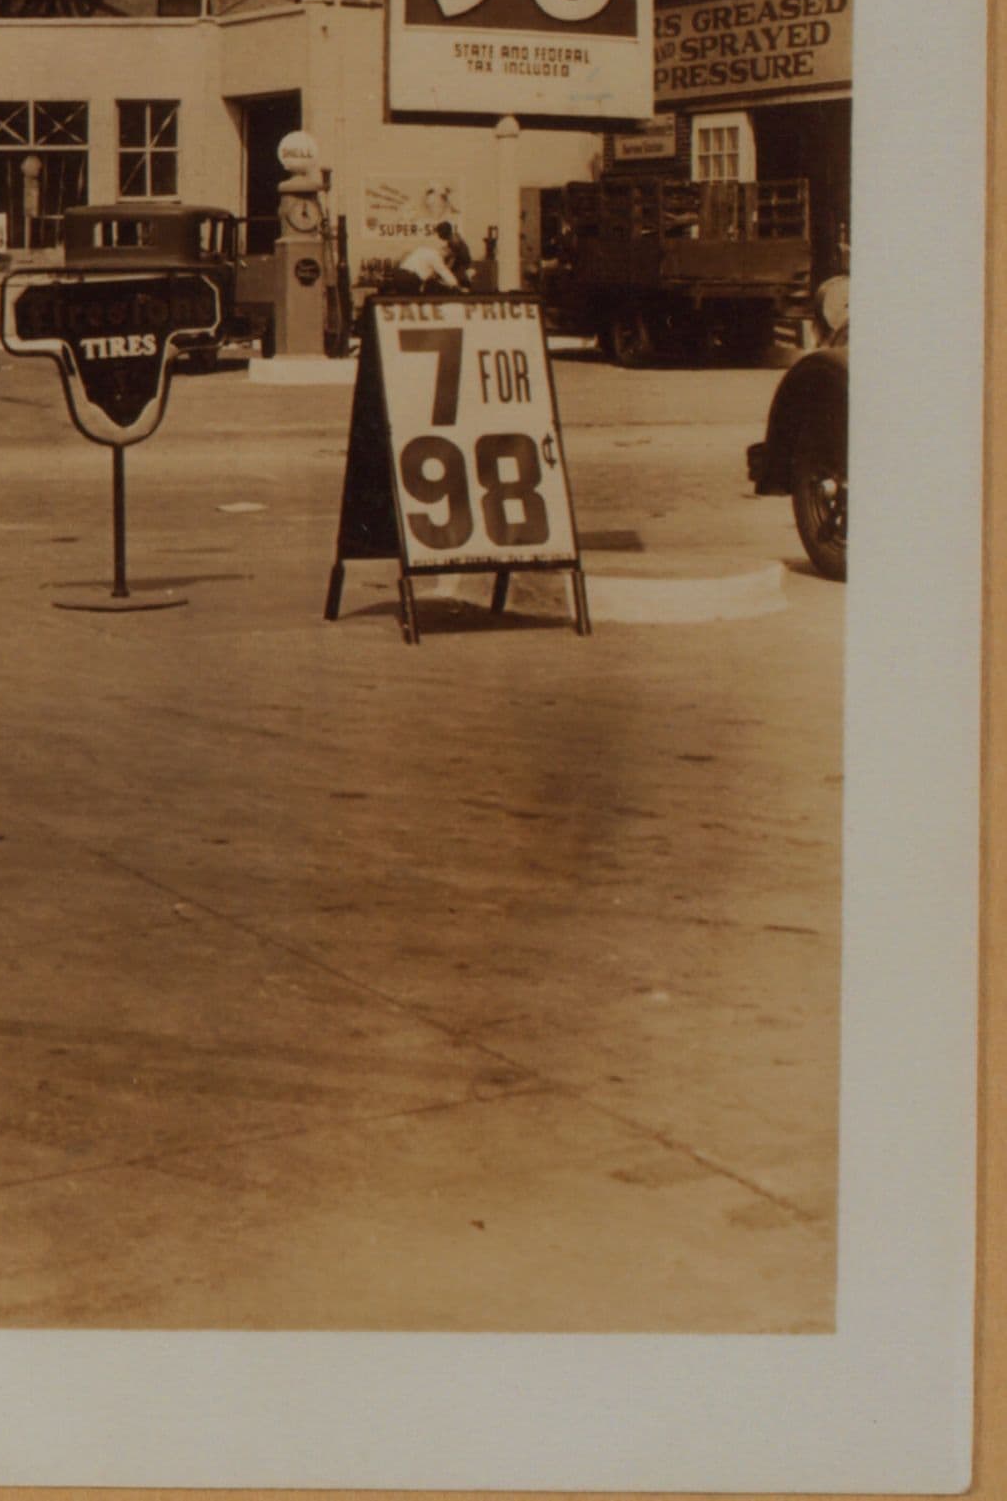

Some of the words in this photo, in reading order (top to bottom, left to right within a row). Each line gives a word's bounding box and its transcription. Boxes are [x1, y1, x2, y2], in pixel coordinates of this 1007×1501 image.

[454, 43, 493, 59] STATE
[500, 45, 528, 60] AND
[535, 47, 590, 64] FEDERAL
[680, 20, 831, 62] SPRAYED
[467, 59, 492, 73] TAX
[504, 61, 570, 77] INCLUDED
[654, 51, 814, 92] PRESSURE
[80, 334, 157, 359] TIRES
[398, 328, 463, 426] 7
[479, 349, 531, 404] FOR
